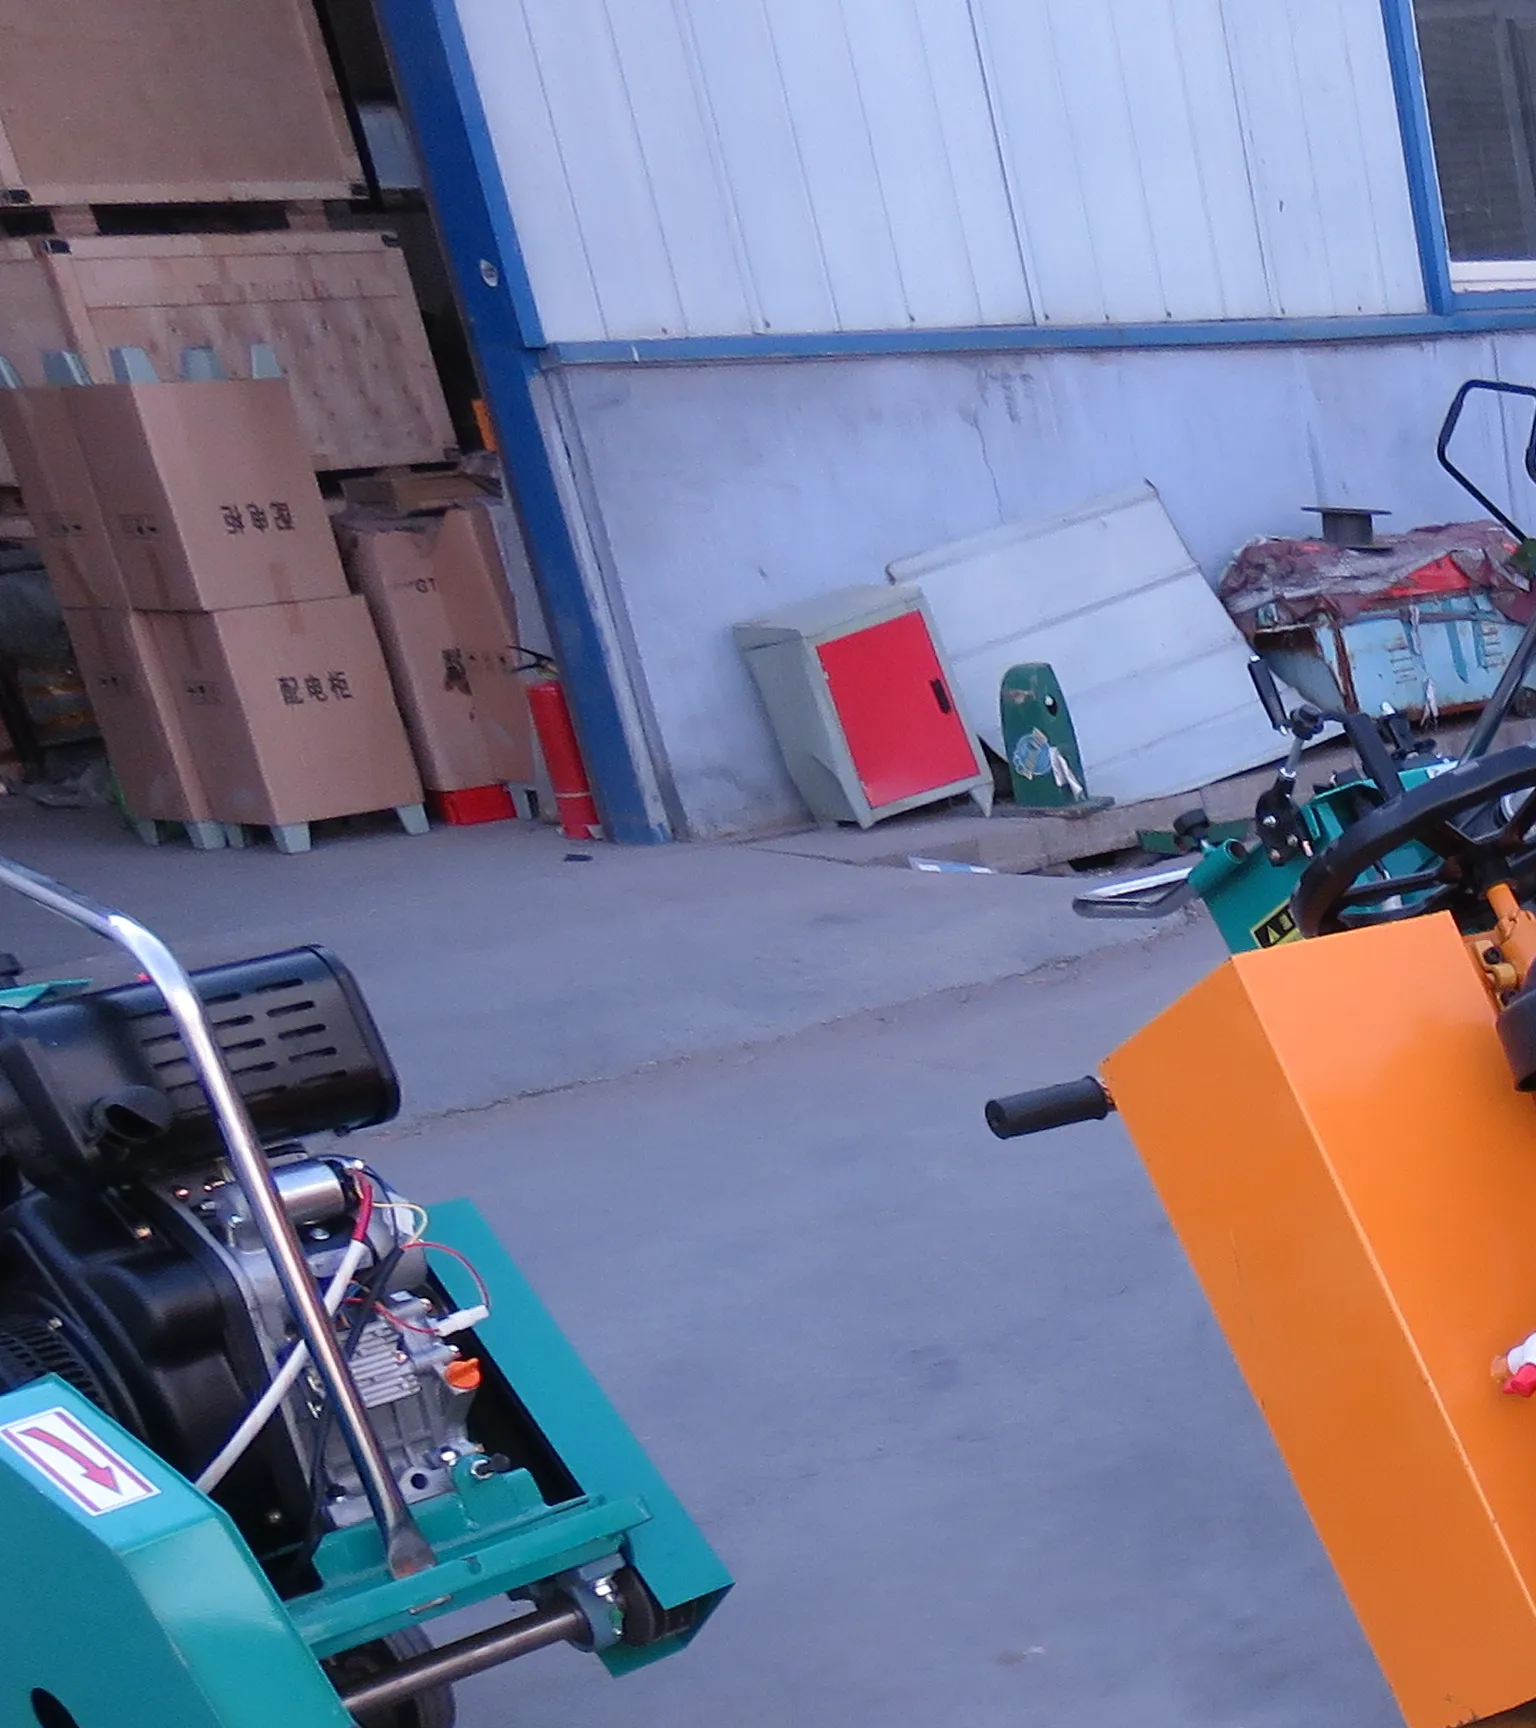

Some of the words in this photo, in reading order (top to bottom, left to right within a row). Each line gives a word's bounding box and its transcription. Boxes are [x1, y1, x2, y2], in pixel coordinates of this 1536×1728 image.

[220, 501, 296, 535] 配电柜
[278, 671, 353, 706] 配电柜
